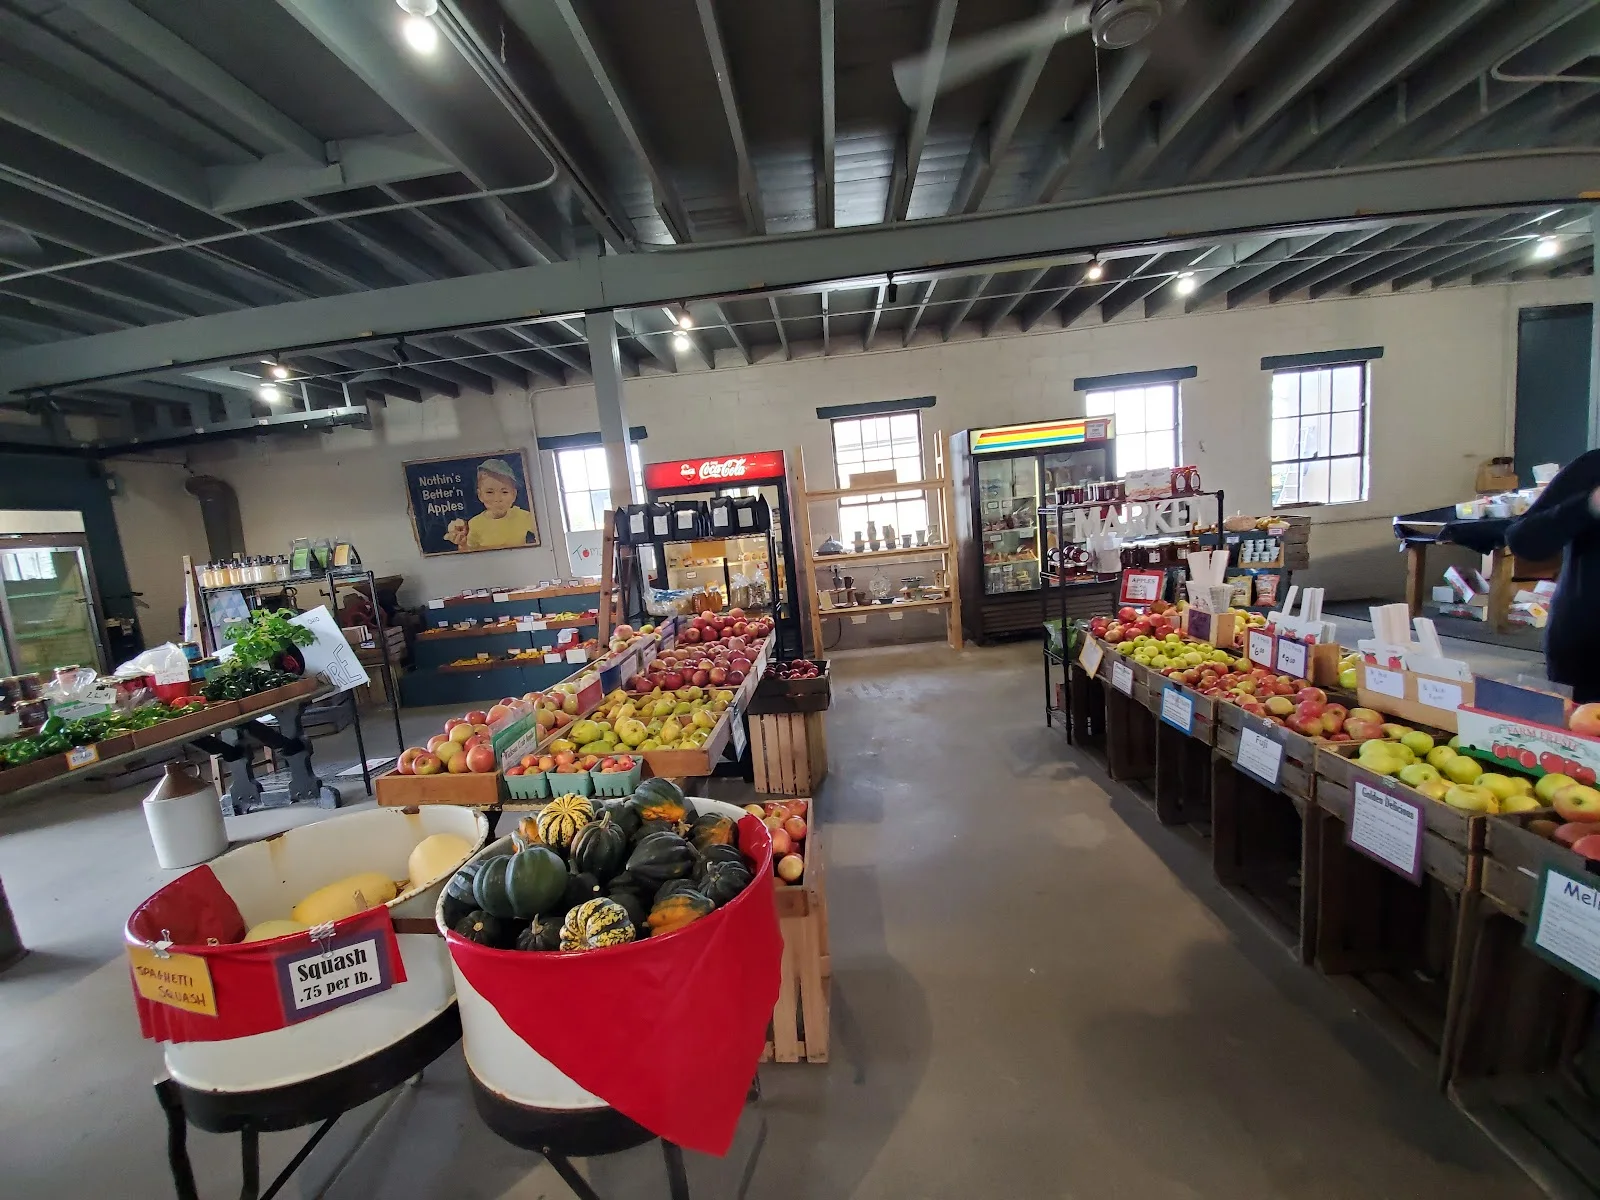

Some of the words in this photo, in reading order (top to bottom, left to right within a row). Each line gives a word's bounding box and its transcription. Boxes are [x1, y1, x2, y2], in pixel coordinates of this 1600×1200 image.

[419, 473, 461, 487] Nothin's
[422, 487, 464, 501] Better'n
[428, 501, 464, 516] Apples
[1073, 494, 1217, 543] MARKET
[1256, 735, 1268, 748] Fuji
[1506, 726, 1536, 737] FARM
[1540, 731, 1579, 750] FRESH
[1362, 787, 1383, 805] Golden
[1384, 796, 1414, 819] Delicious
[298, 948, 367, 982] Squash
[136, 966, 193, 987] SPAGHETTI
[300, 985, 322, 1002] .75
[326, 977, 350, 995] per
[354, 971, 373, 985] lb.
[158, 985, 206, 1006] SQUASH
